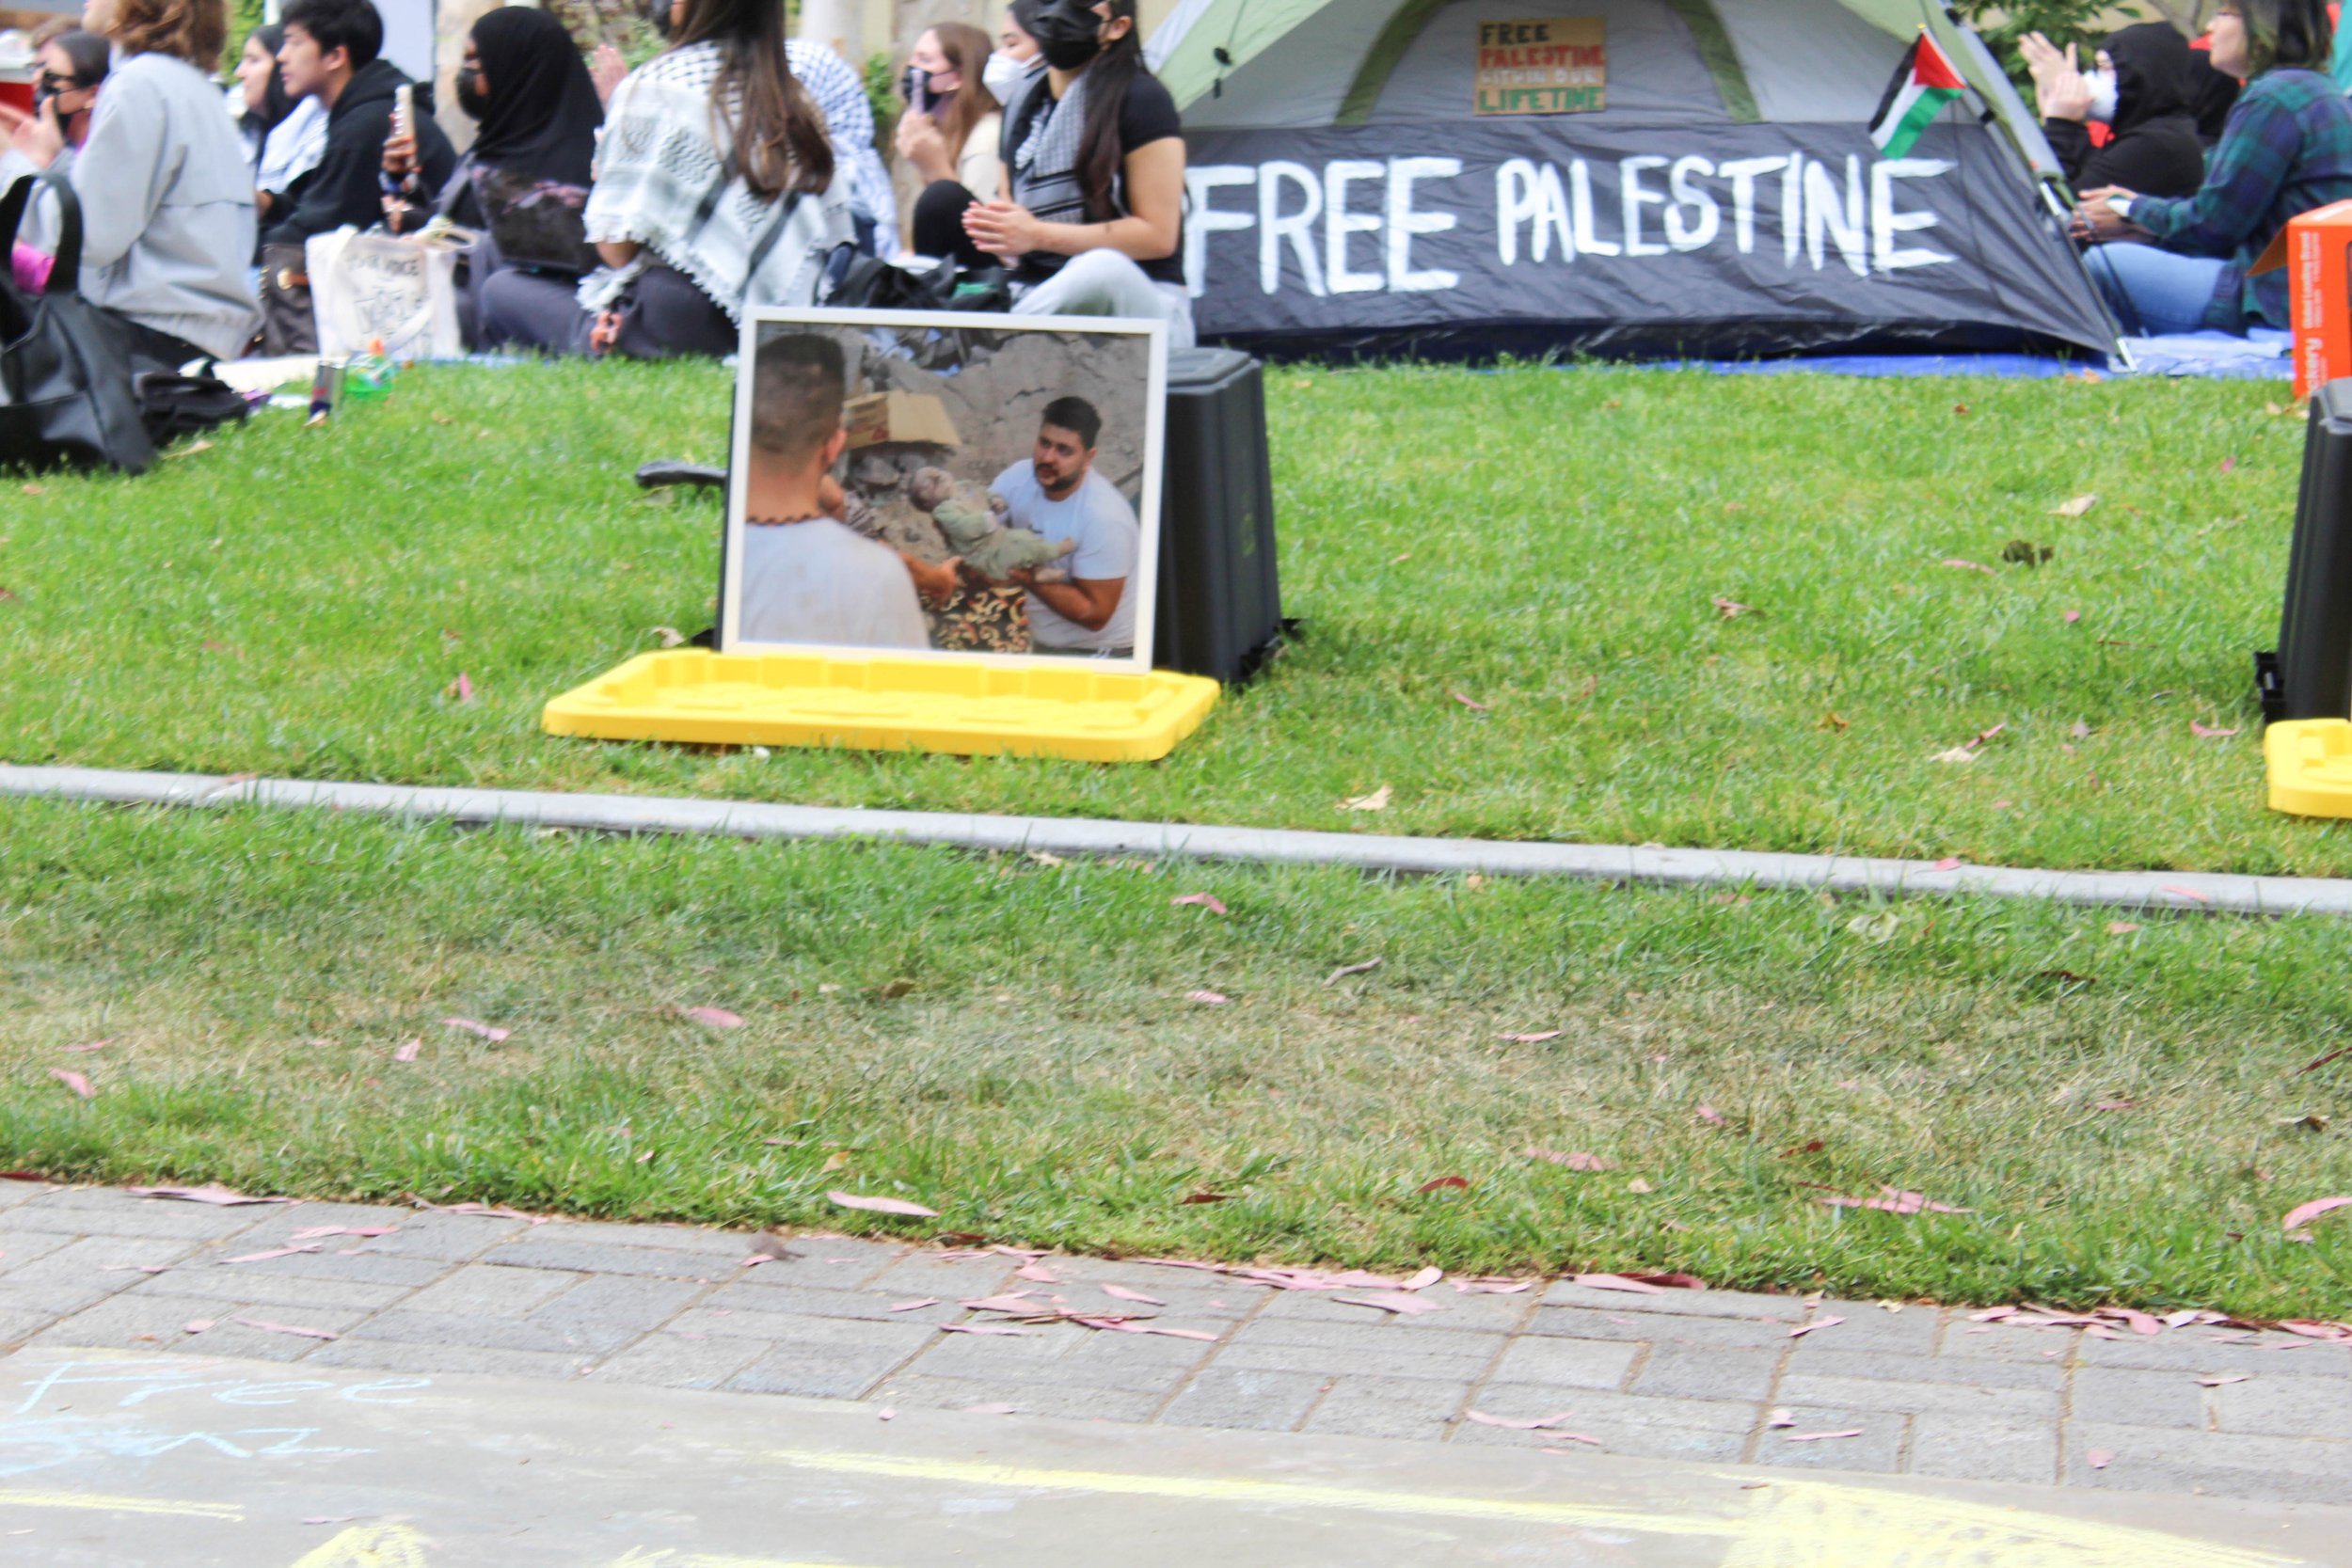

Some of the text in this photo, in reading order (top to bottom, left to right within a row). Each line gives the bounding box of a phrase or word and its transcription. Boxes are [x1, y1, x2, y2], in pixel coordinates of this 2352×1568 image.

[1480, 24, 1549, 44] FREE
[1480, 45, 1604, 68] PALESTINE
[1480, 87, 1604, 111] LIFETIME
[1184, 151, 1959, 299] FREE PALESTINE
[15, 1360, 435, 1415] Free
